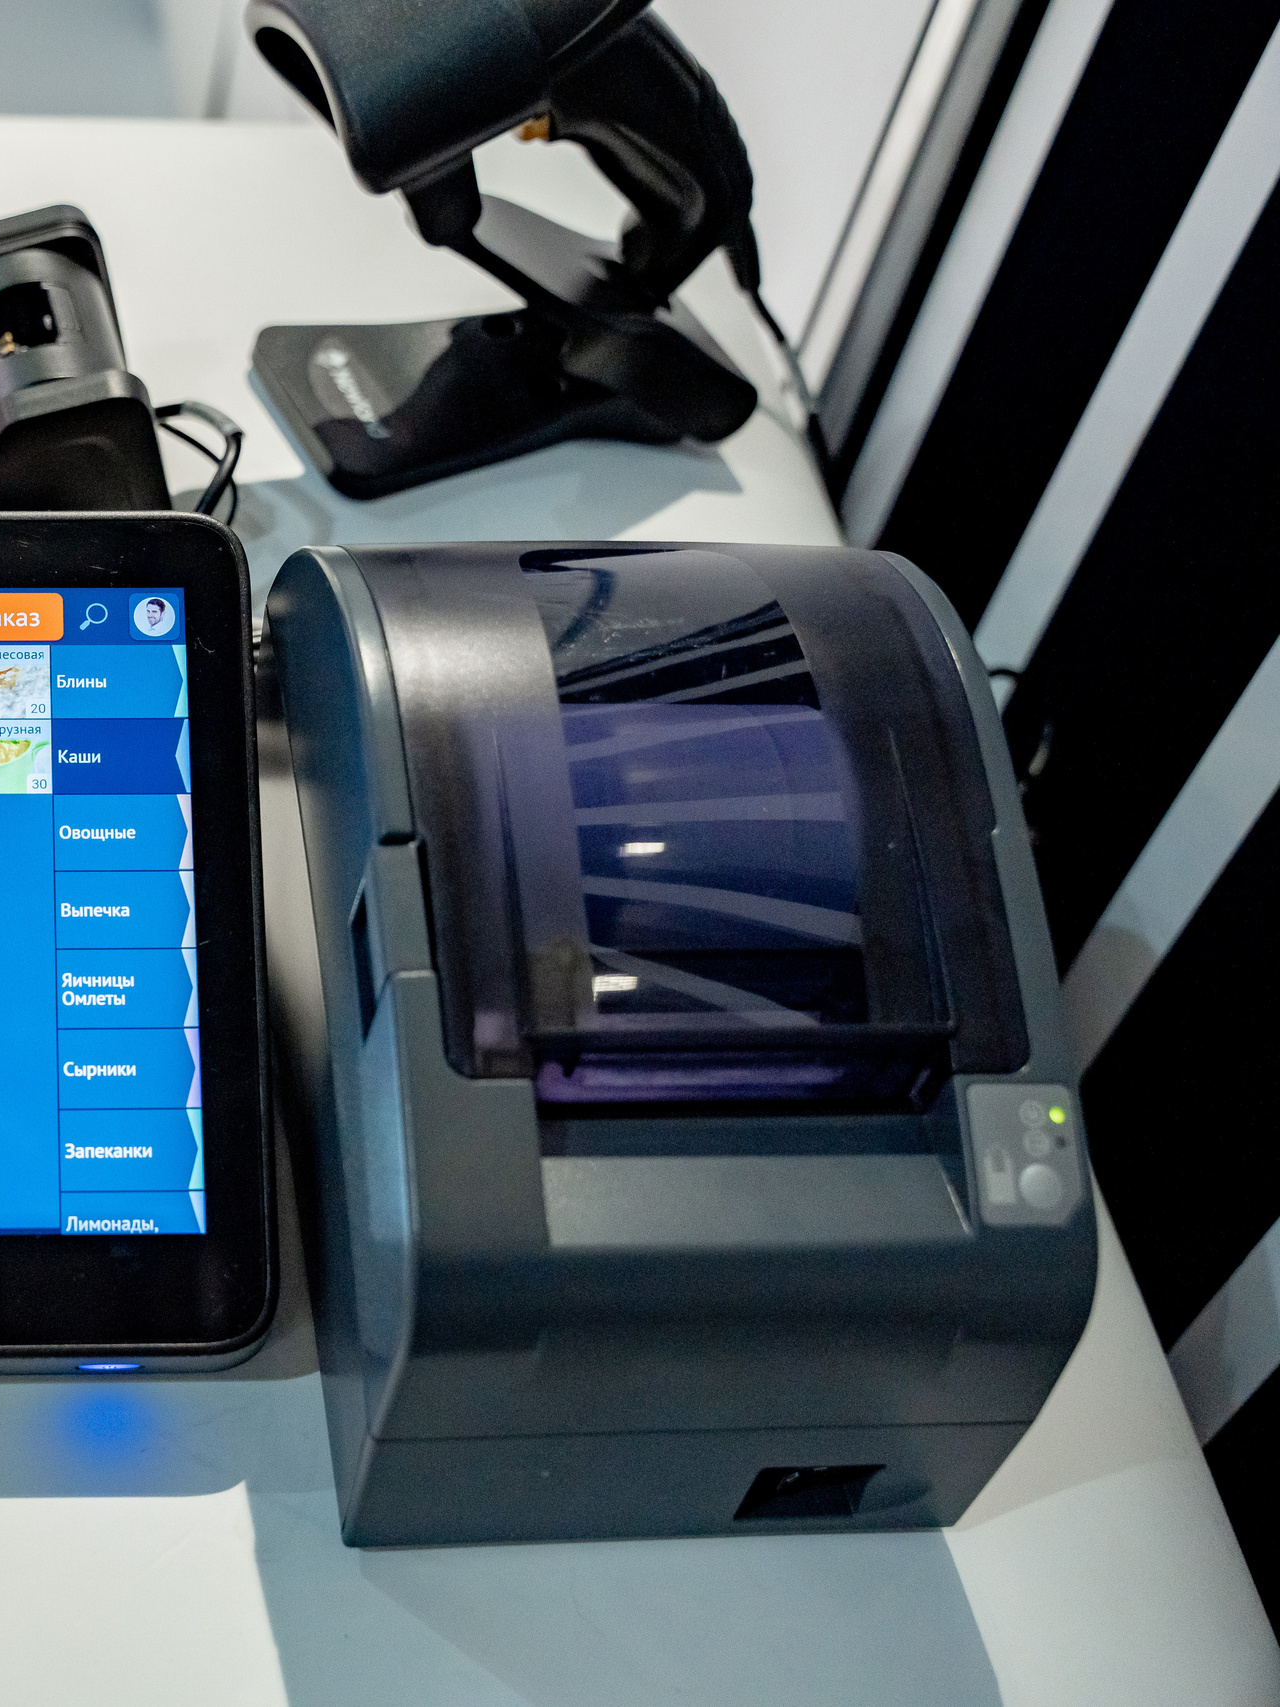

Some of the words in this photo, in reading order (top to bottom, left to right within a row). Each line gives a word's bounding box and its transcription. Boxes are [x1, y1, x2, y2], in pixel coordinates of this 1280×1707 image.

[56, 674, 107, 689] Блины
[30, 703, 46, 714] 20
[58, 750, 102, 764] Каши
[32, 778, 48, 790] 30
[59, 825, 136, 842] Овощные
[60, 903, 131, 918] Выпечка
[61, 973, 135, 990] Яичницы
[62, 991, 126, 1007] Омлеты
[63, 1061, 137, 1081] Сырники
[64, 1144, 153, 1159] Запеканки
[65, 1215, 160, 1234] Лимонады,
